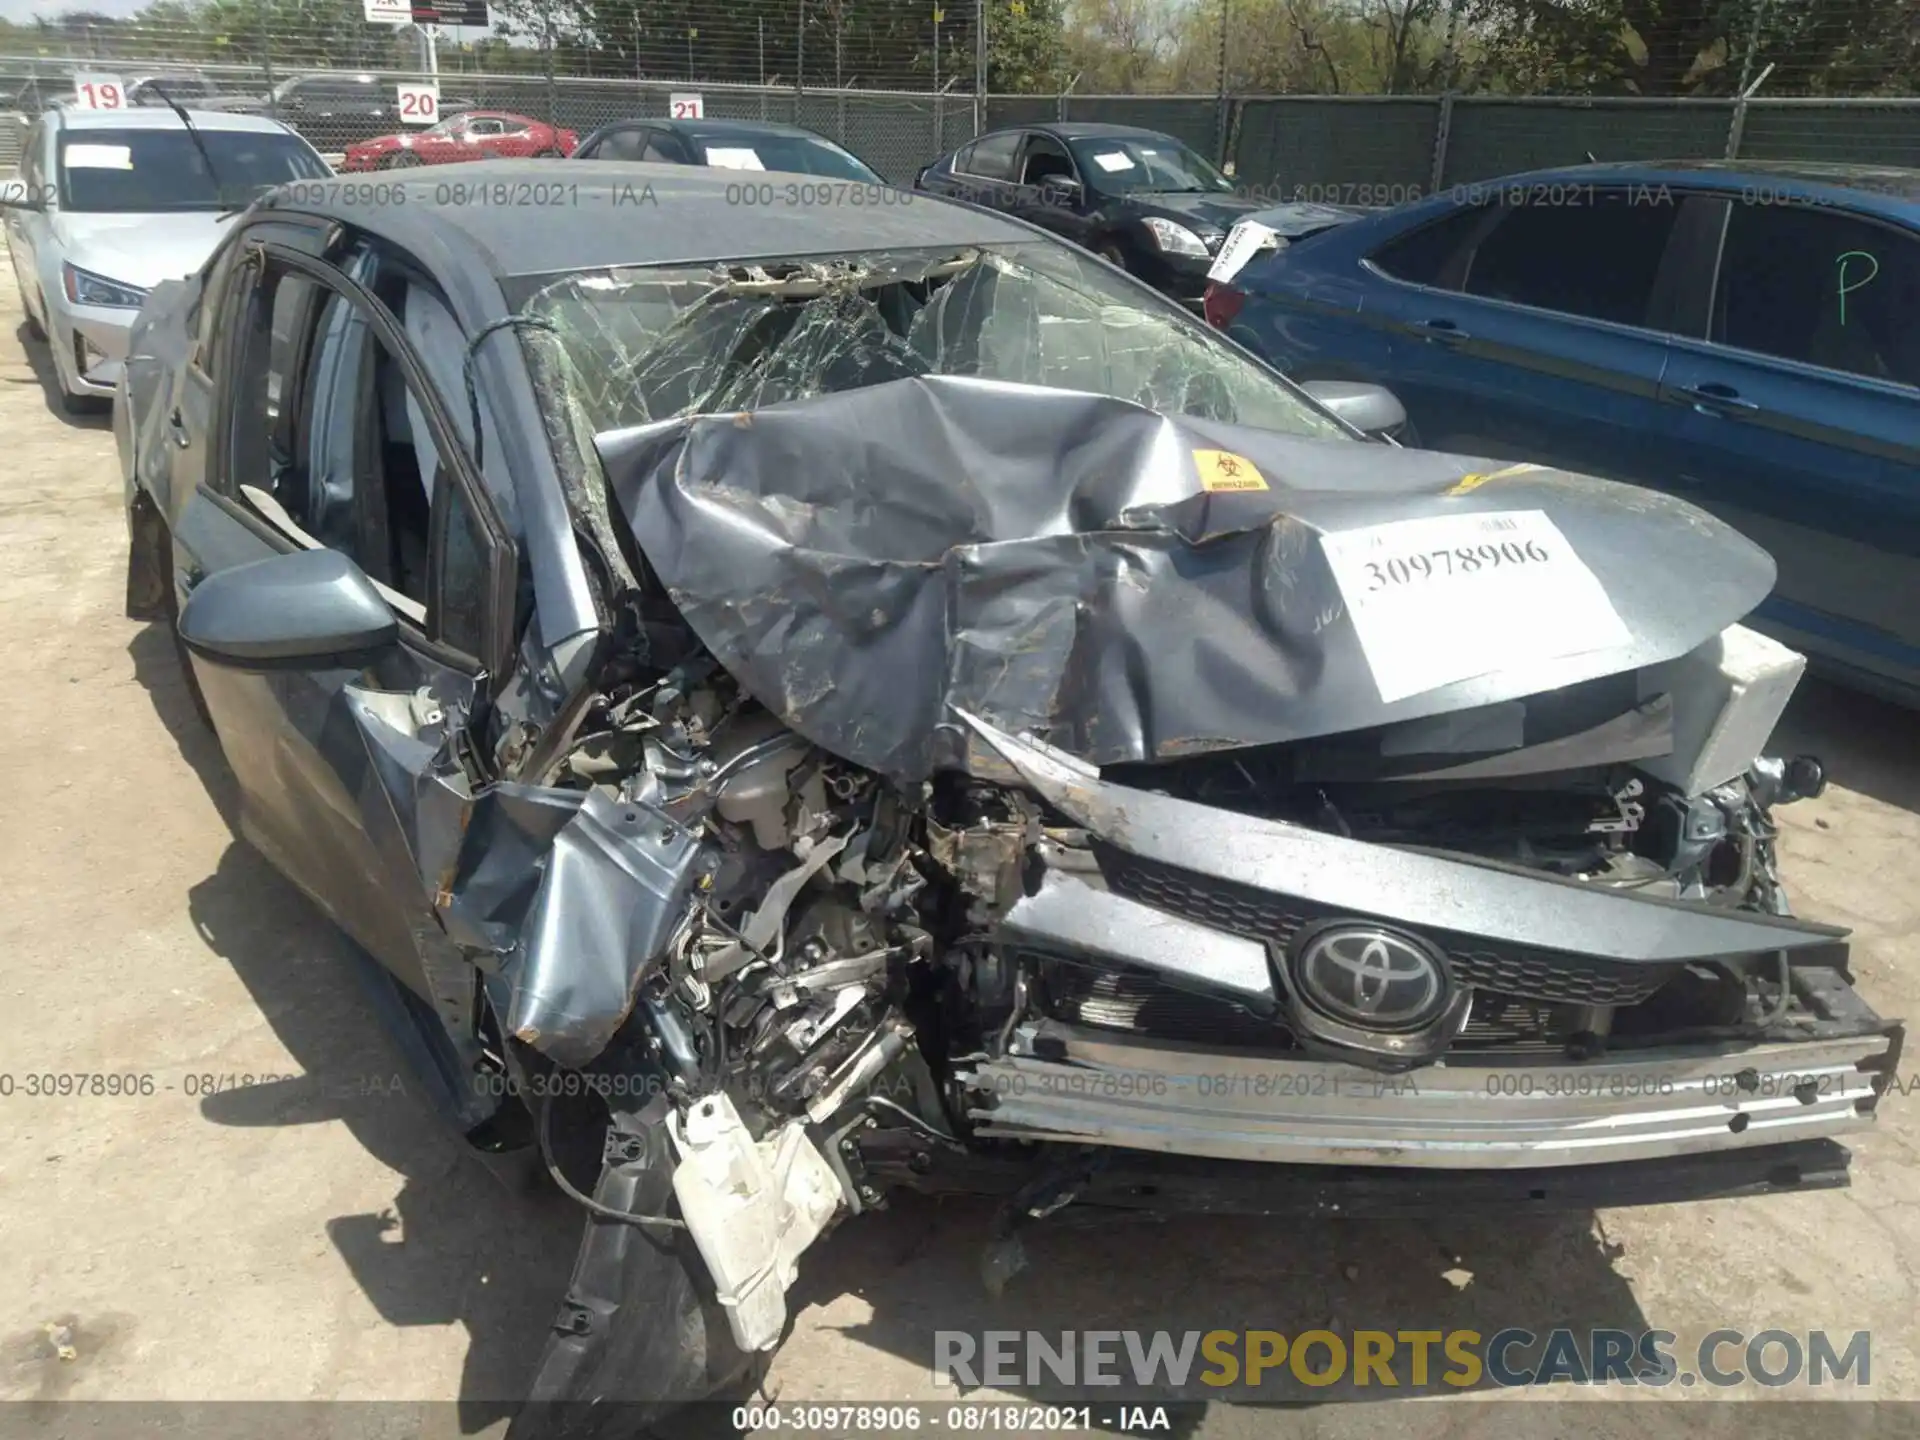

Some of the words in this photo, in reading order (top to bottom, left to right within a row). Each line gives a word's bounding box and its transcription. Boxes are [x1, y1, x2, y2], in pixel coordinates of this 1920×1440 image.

[82, 81, 119, 109] 19
[402, 93, 434, 116] 20
[674, 102, 697, 119] 21
[1836, 251, 1878, 325] P
[1364, 539, 1549, 591] 30978906
